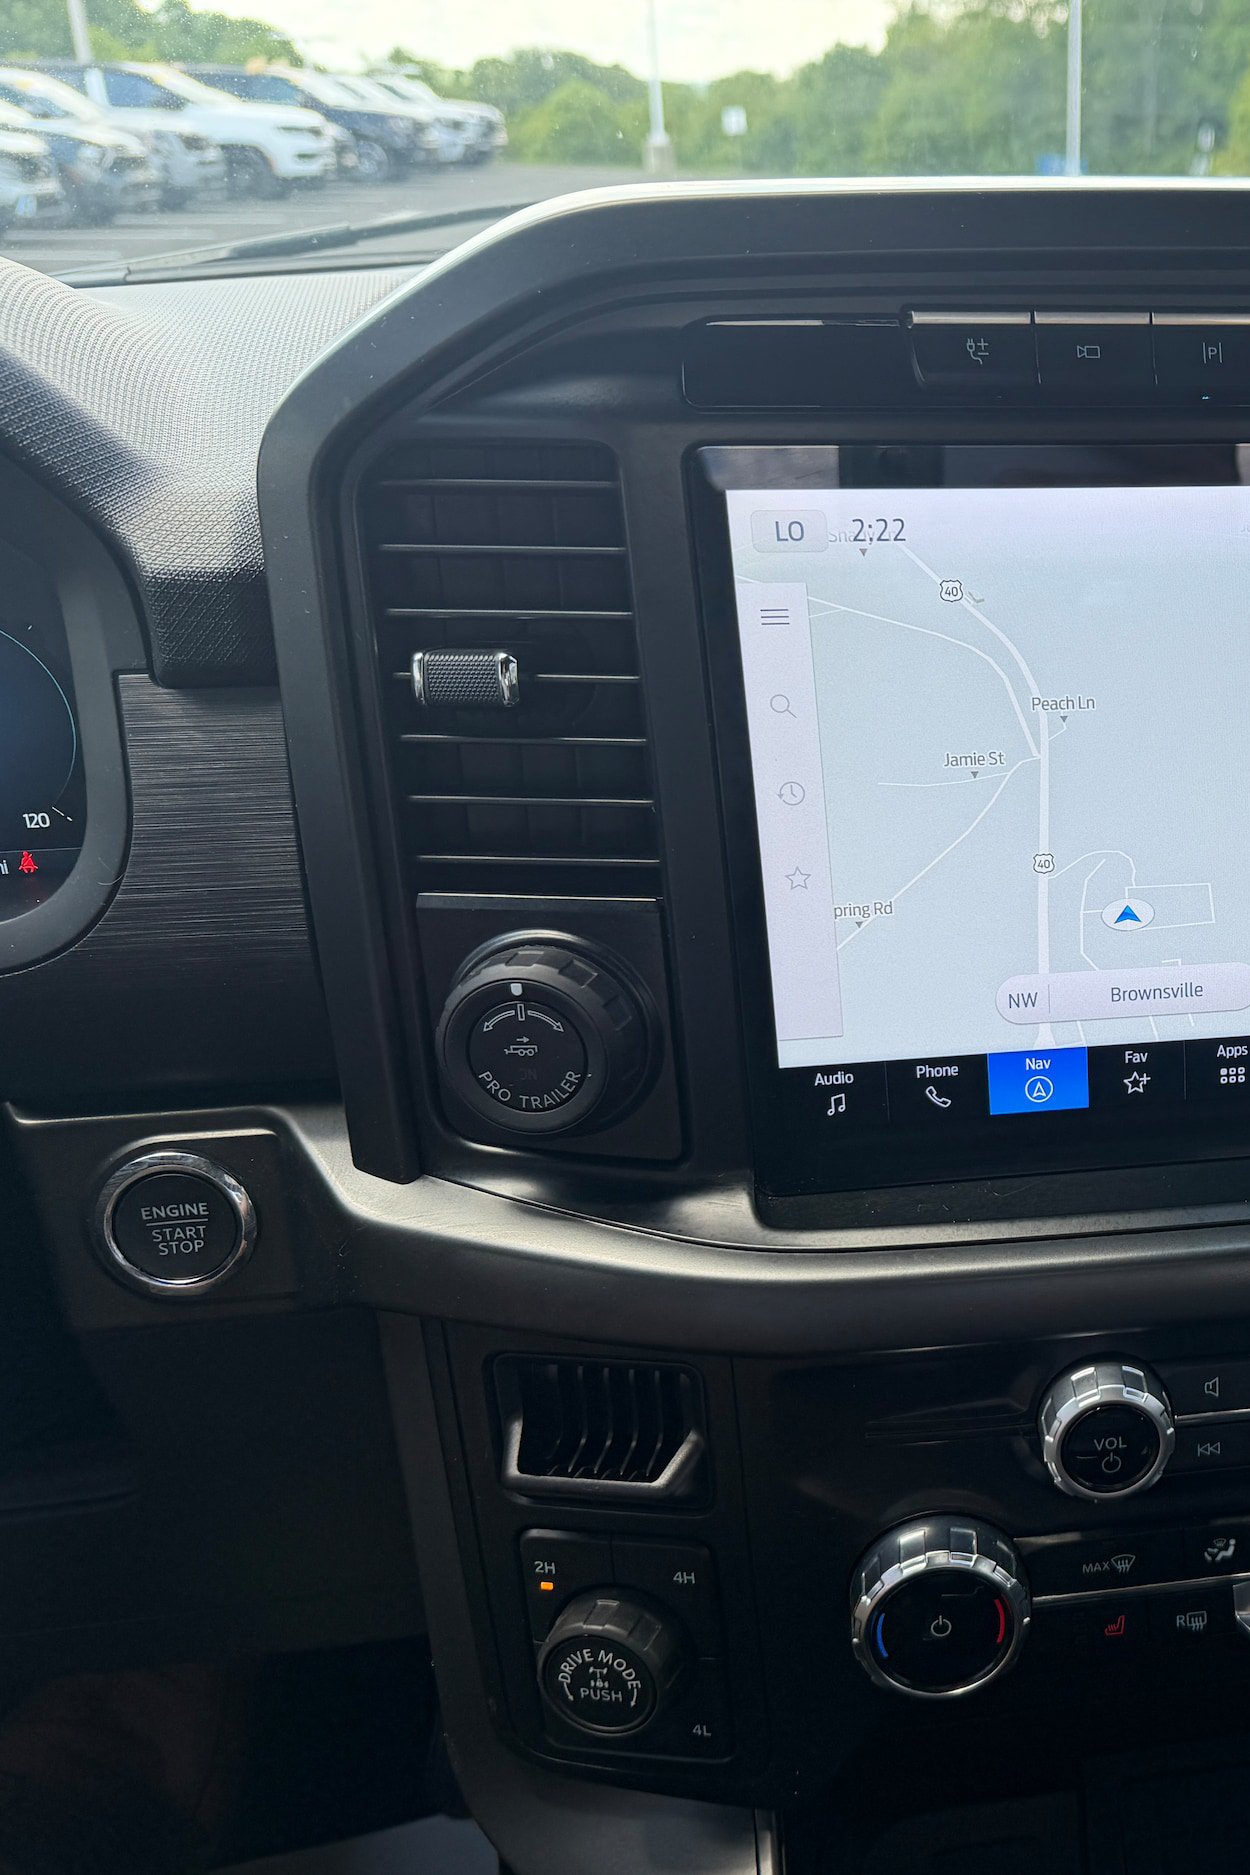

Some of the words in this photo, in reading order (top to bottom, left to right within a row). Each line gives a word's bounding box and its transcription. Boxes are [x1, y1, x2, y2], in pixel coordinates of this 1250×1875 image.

[775, 520, 804, 542] LO
[852, 518, 906, 543] 2:22
[944, 585, 959, 598] 40
[1031, 695, 1075, 711] Peach
[1076, 695, 1095, 709] Ln
[943, 752, 985, 767] Jamie
[987, 750, 1005, 765] St
[23, 813, 50, 828] 120
[1037, 859, 1051, 869] 40
[873, 901, 893, 914] Rd
[1007, 992, 1039, 1008] NW
[1110, 982, 1204, 1003] Brownsville
[1125, 1050, 1149, 1064] Fav
[1216, 1043, 1249, 1060] Apps
[915, 1063, 960, 1079] Phone
[1025, 1056, 1051, 1071] Nav
[814, 1070, 855, 1086] Audio
[478, 1070, 512, 1102] PRO
[519, 1070, 582, 1109] TRAILER
[140, 1202, 210, 1221] ENGINE
[152, 1225, 207, 1242] START
[158, 1239, 205, 1256] STOP
[1093, 1436, 1128, 1450] VOL
[534, 1561, 556, 1575] 2H
[1082, 1561, 1111, 1575] MAX
[673, 1571, 696, 1585] 4H
[558, 1648, 594, 1684] DRIVE
[598, 1649, 642, 1690] MODE
[580, 1687, 623, 1702] PUSH
[692, 1724, 712, 1737] 4L
